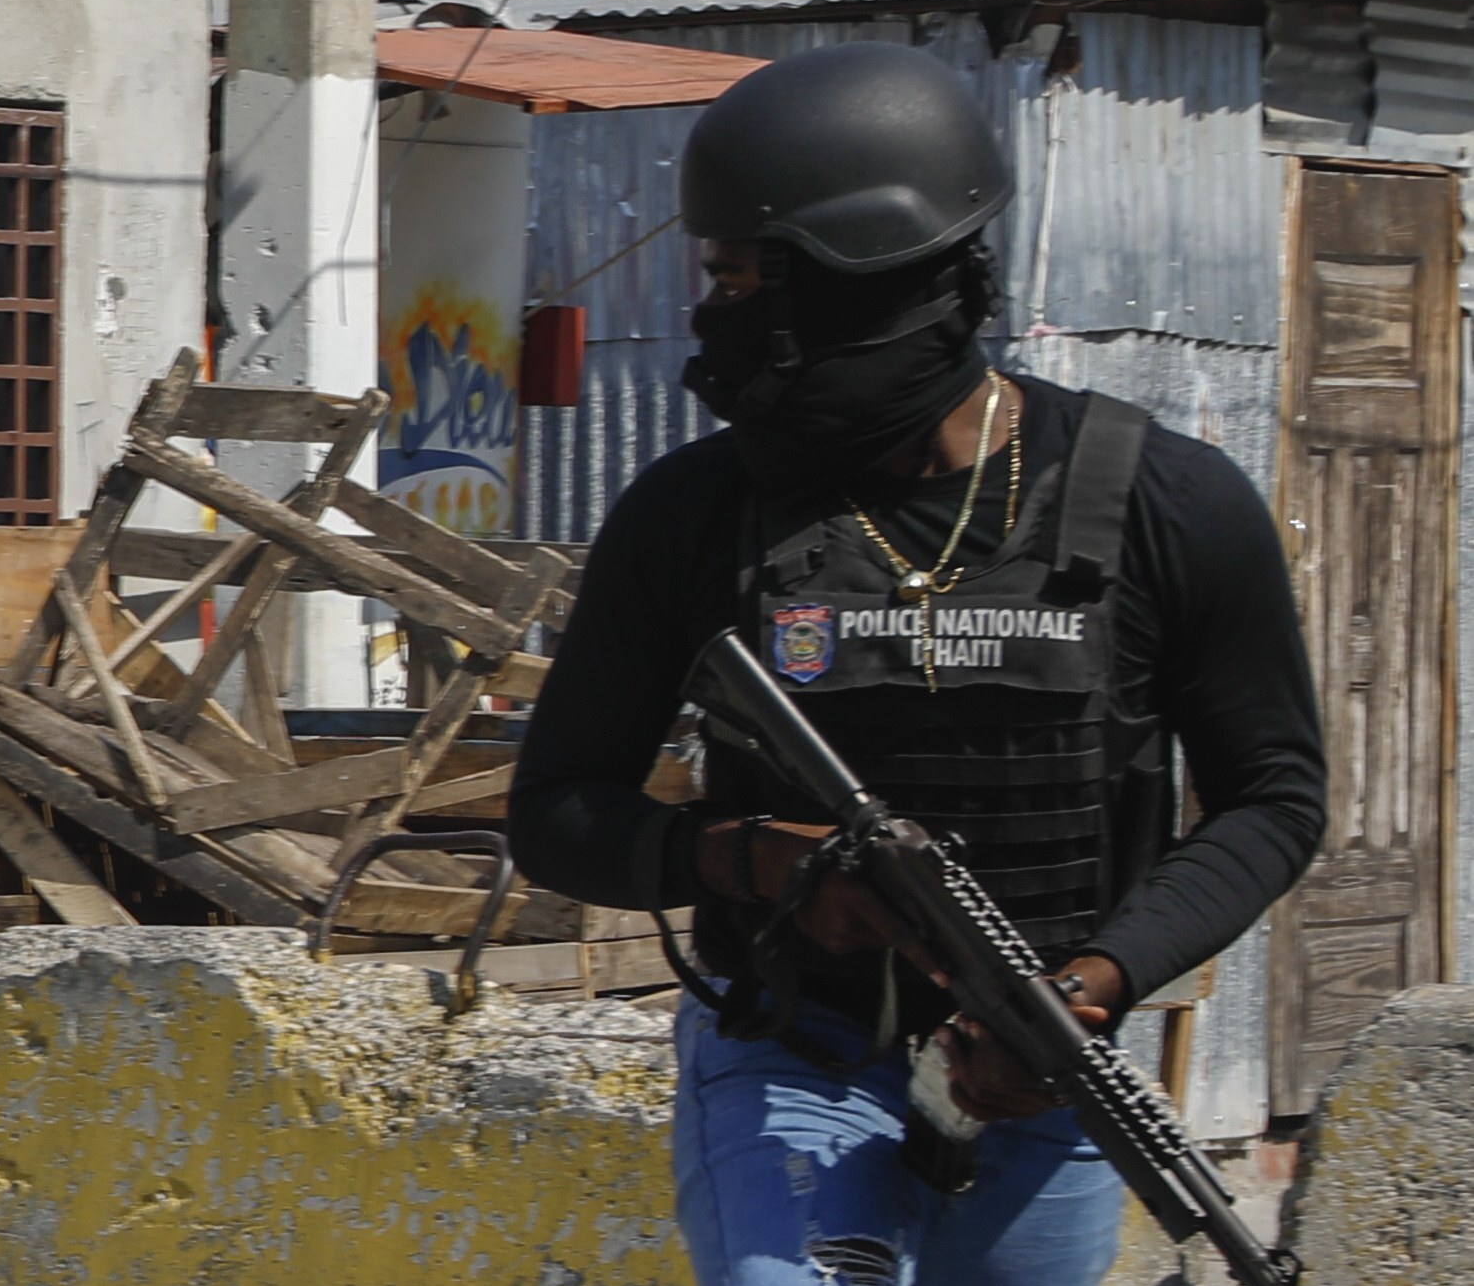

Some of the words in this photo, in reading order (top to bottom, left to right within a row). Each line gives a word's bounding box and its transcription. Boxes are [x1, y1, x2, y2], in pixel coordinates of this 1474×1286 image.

[839, 609, 927, 639] POLICE
[935, 608, 1085, 641] NATIONALE
[910, 638, 1004, 667] DHAITI
